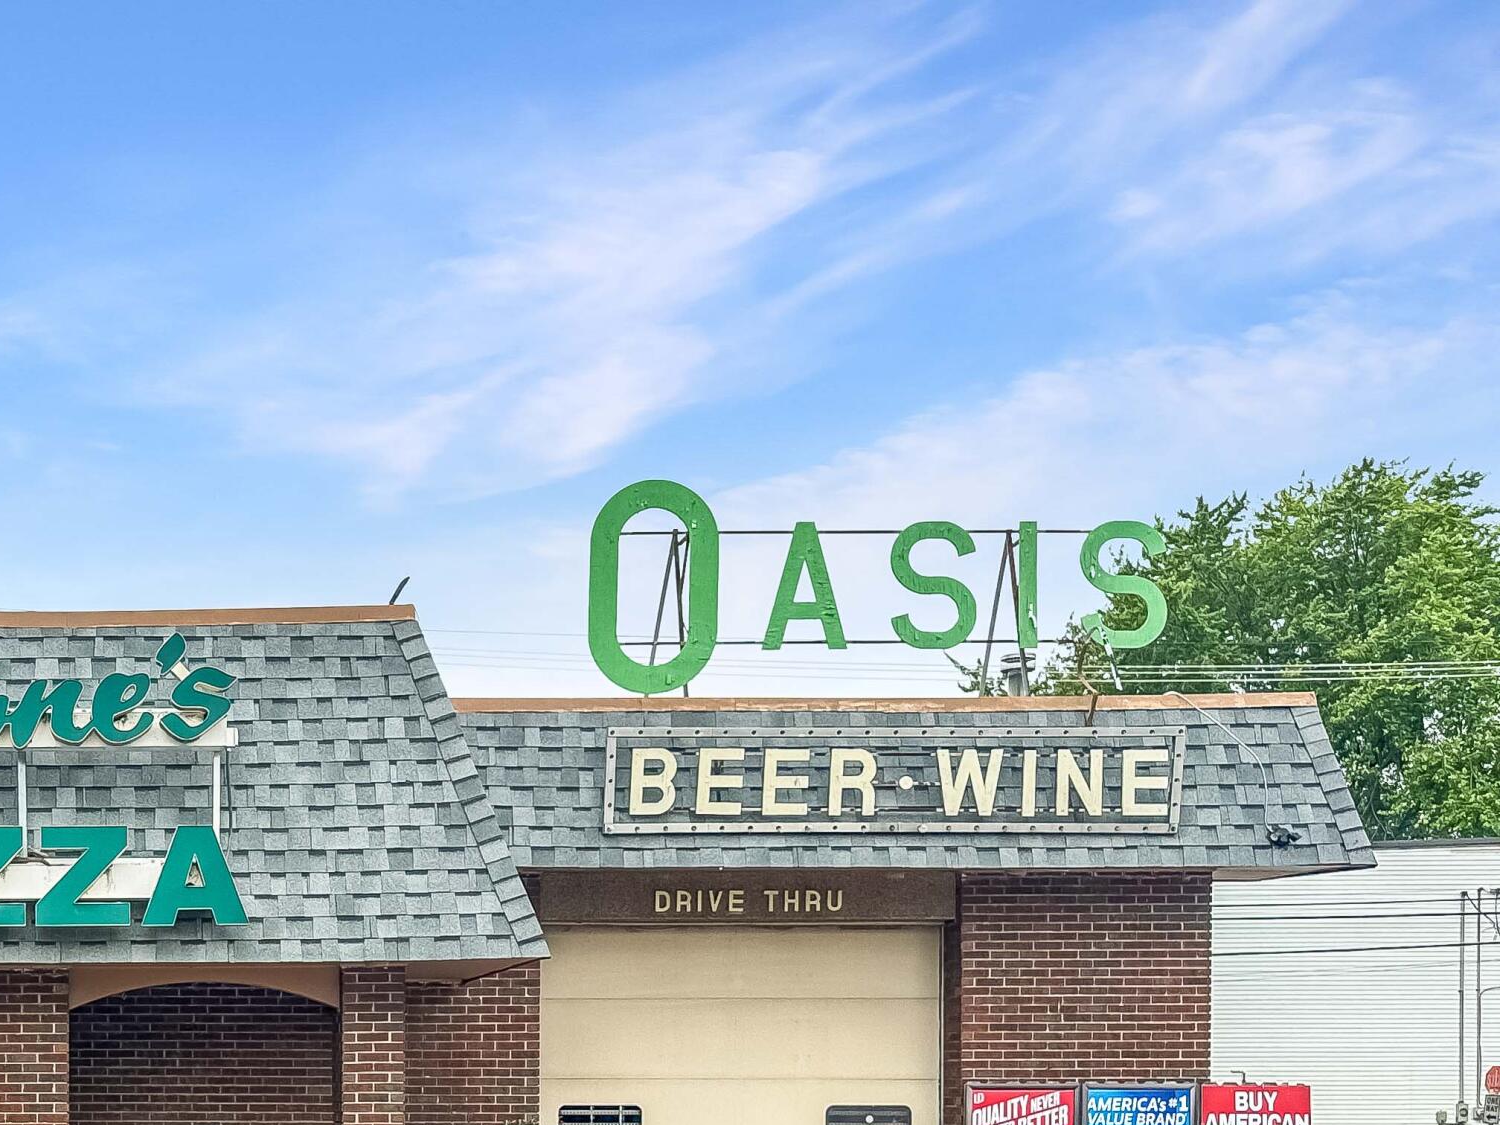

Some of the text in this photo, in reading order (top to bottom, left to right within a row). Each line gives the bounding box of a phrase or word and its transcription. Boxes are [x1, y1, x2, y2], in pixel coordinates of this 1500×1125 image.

[589, 480, 1168, 694] OASIS
[629, 748, 1170, 817] BEER WINE
[655, 890, 843, 912] DRIVE THRU
[1030, 1091, 1060, 1113] NEVER
[1088, 1095, 1189, 1112] AMERICA's #1
[1235, 1091, 1278, 1111] BUY
[1088, 1112, 1185, 1125] VALUE BRAND
